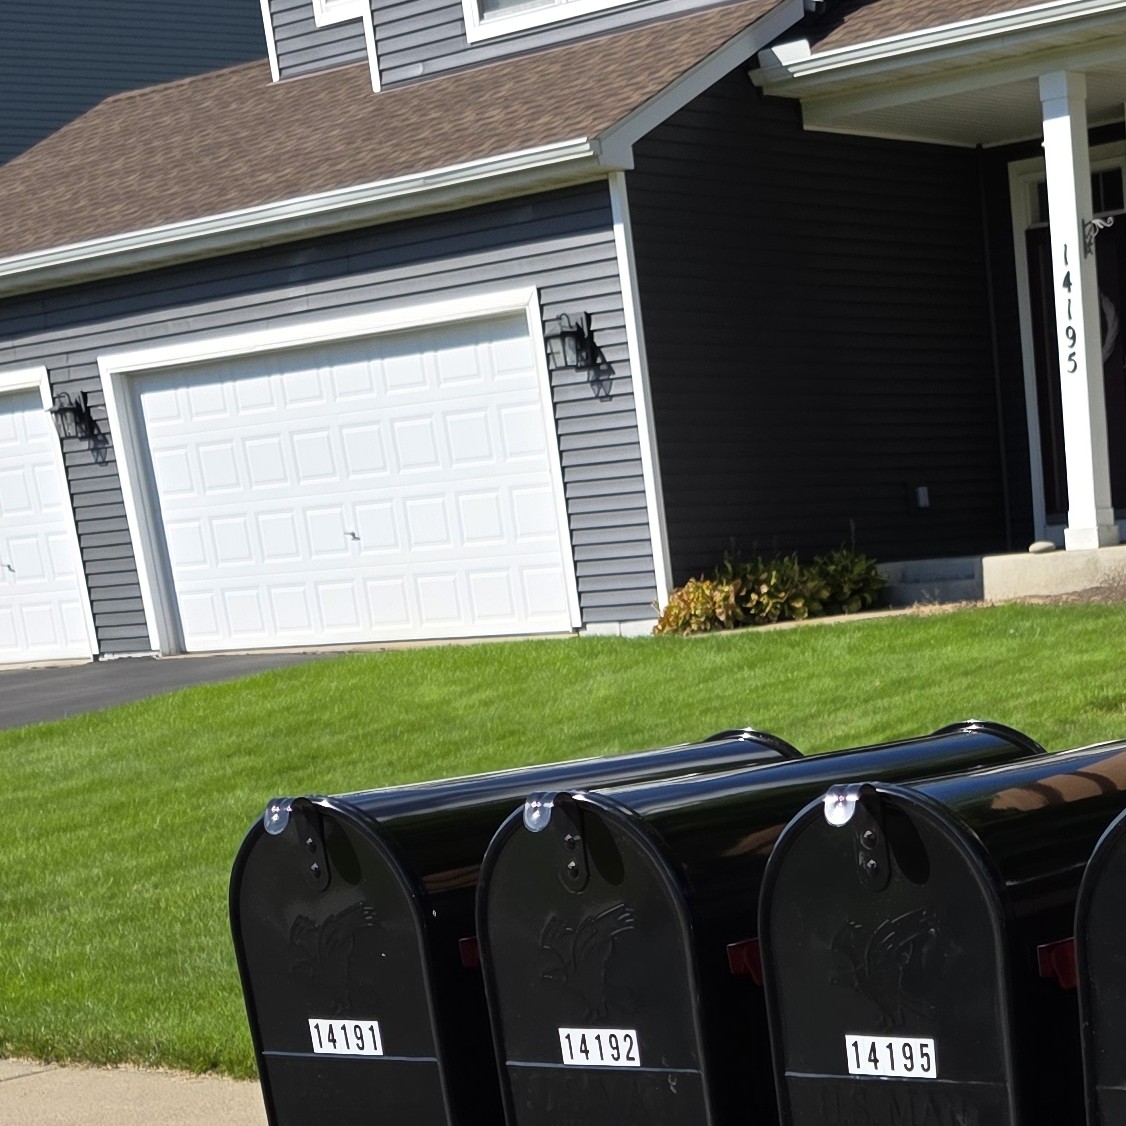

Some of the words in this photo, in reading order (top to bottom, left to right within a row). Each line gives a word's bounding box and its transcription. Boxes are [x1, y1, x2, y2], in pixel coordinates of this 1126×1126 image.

[1062, 243, 1078, 374] 14195
[313, 1022, 378, 1051] 14191
[564, 1033, 636, 1062] 14192
[851, 1040, 931, 1073] 14195
